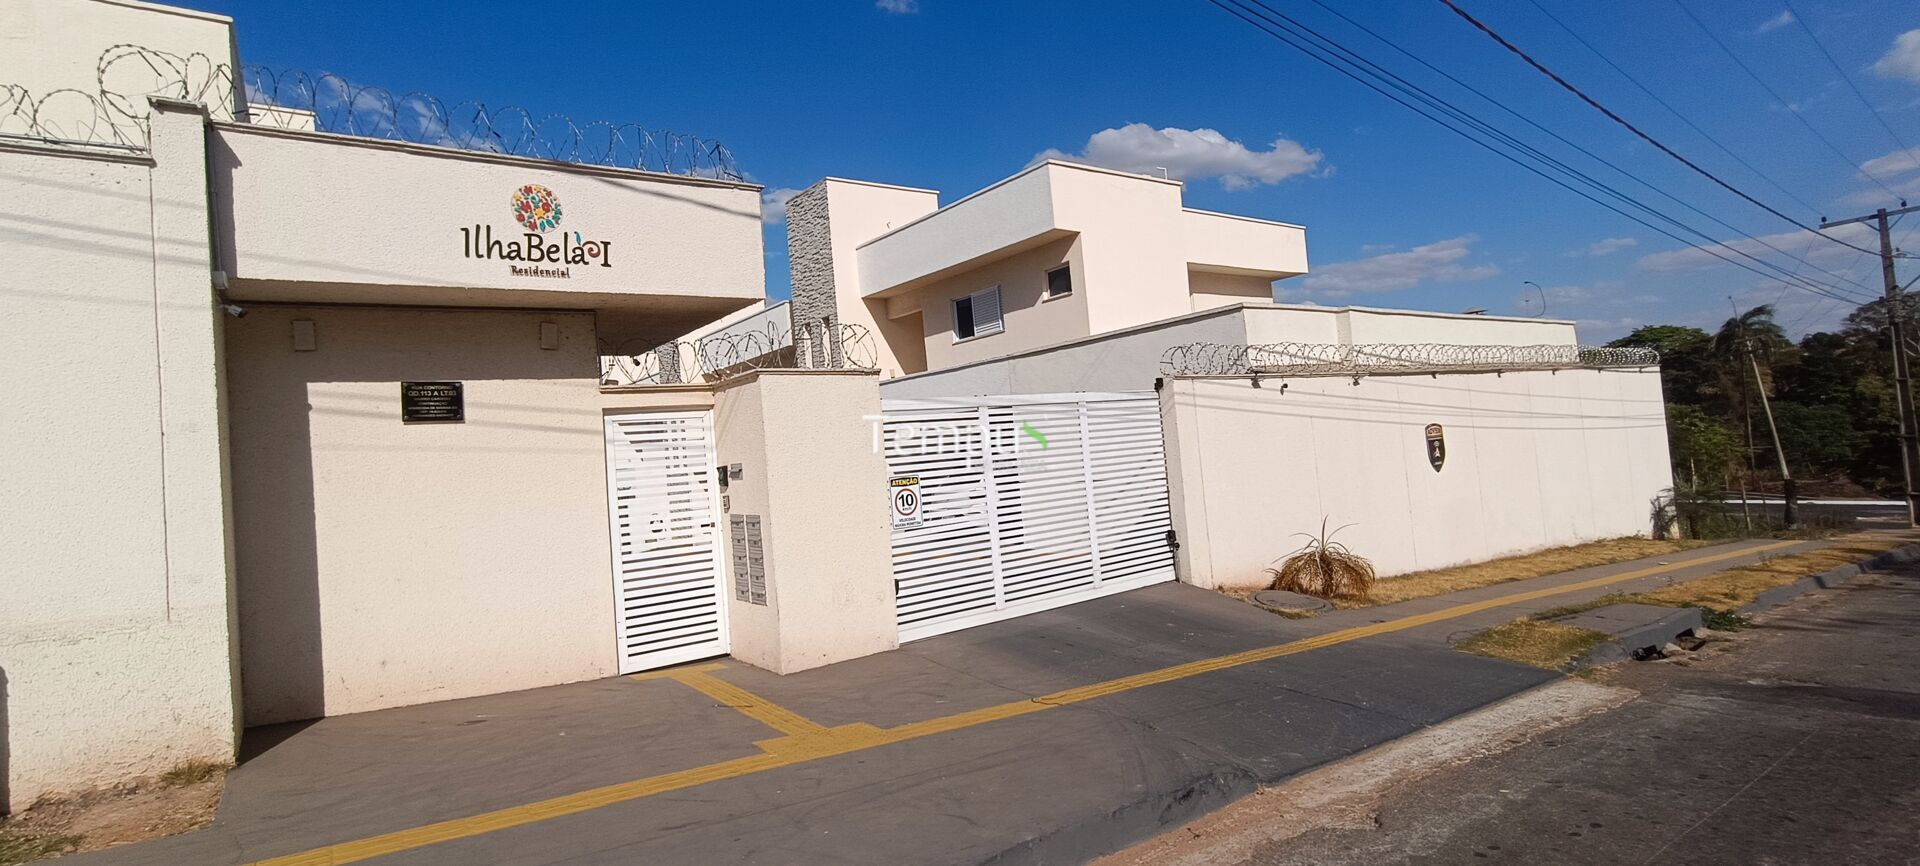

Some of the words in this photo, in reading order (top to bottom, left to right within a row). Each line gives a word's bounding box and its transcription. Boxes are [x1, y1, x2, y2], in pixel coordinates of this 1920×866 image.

[510, 264, 571, 279] Residencial
[891, 477, 918, 486] ATENÇÃO
[899, 494, 914, 507] 10
